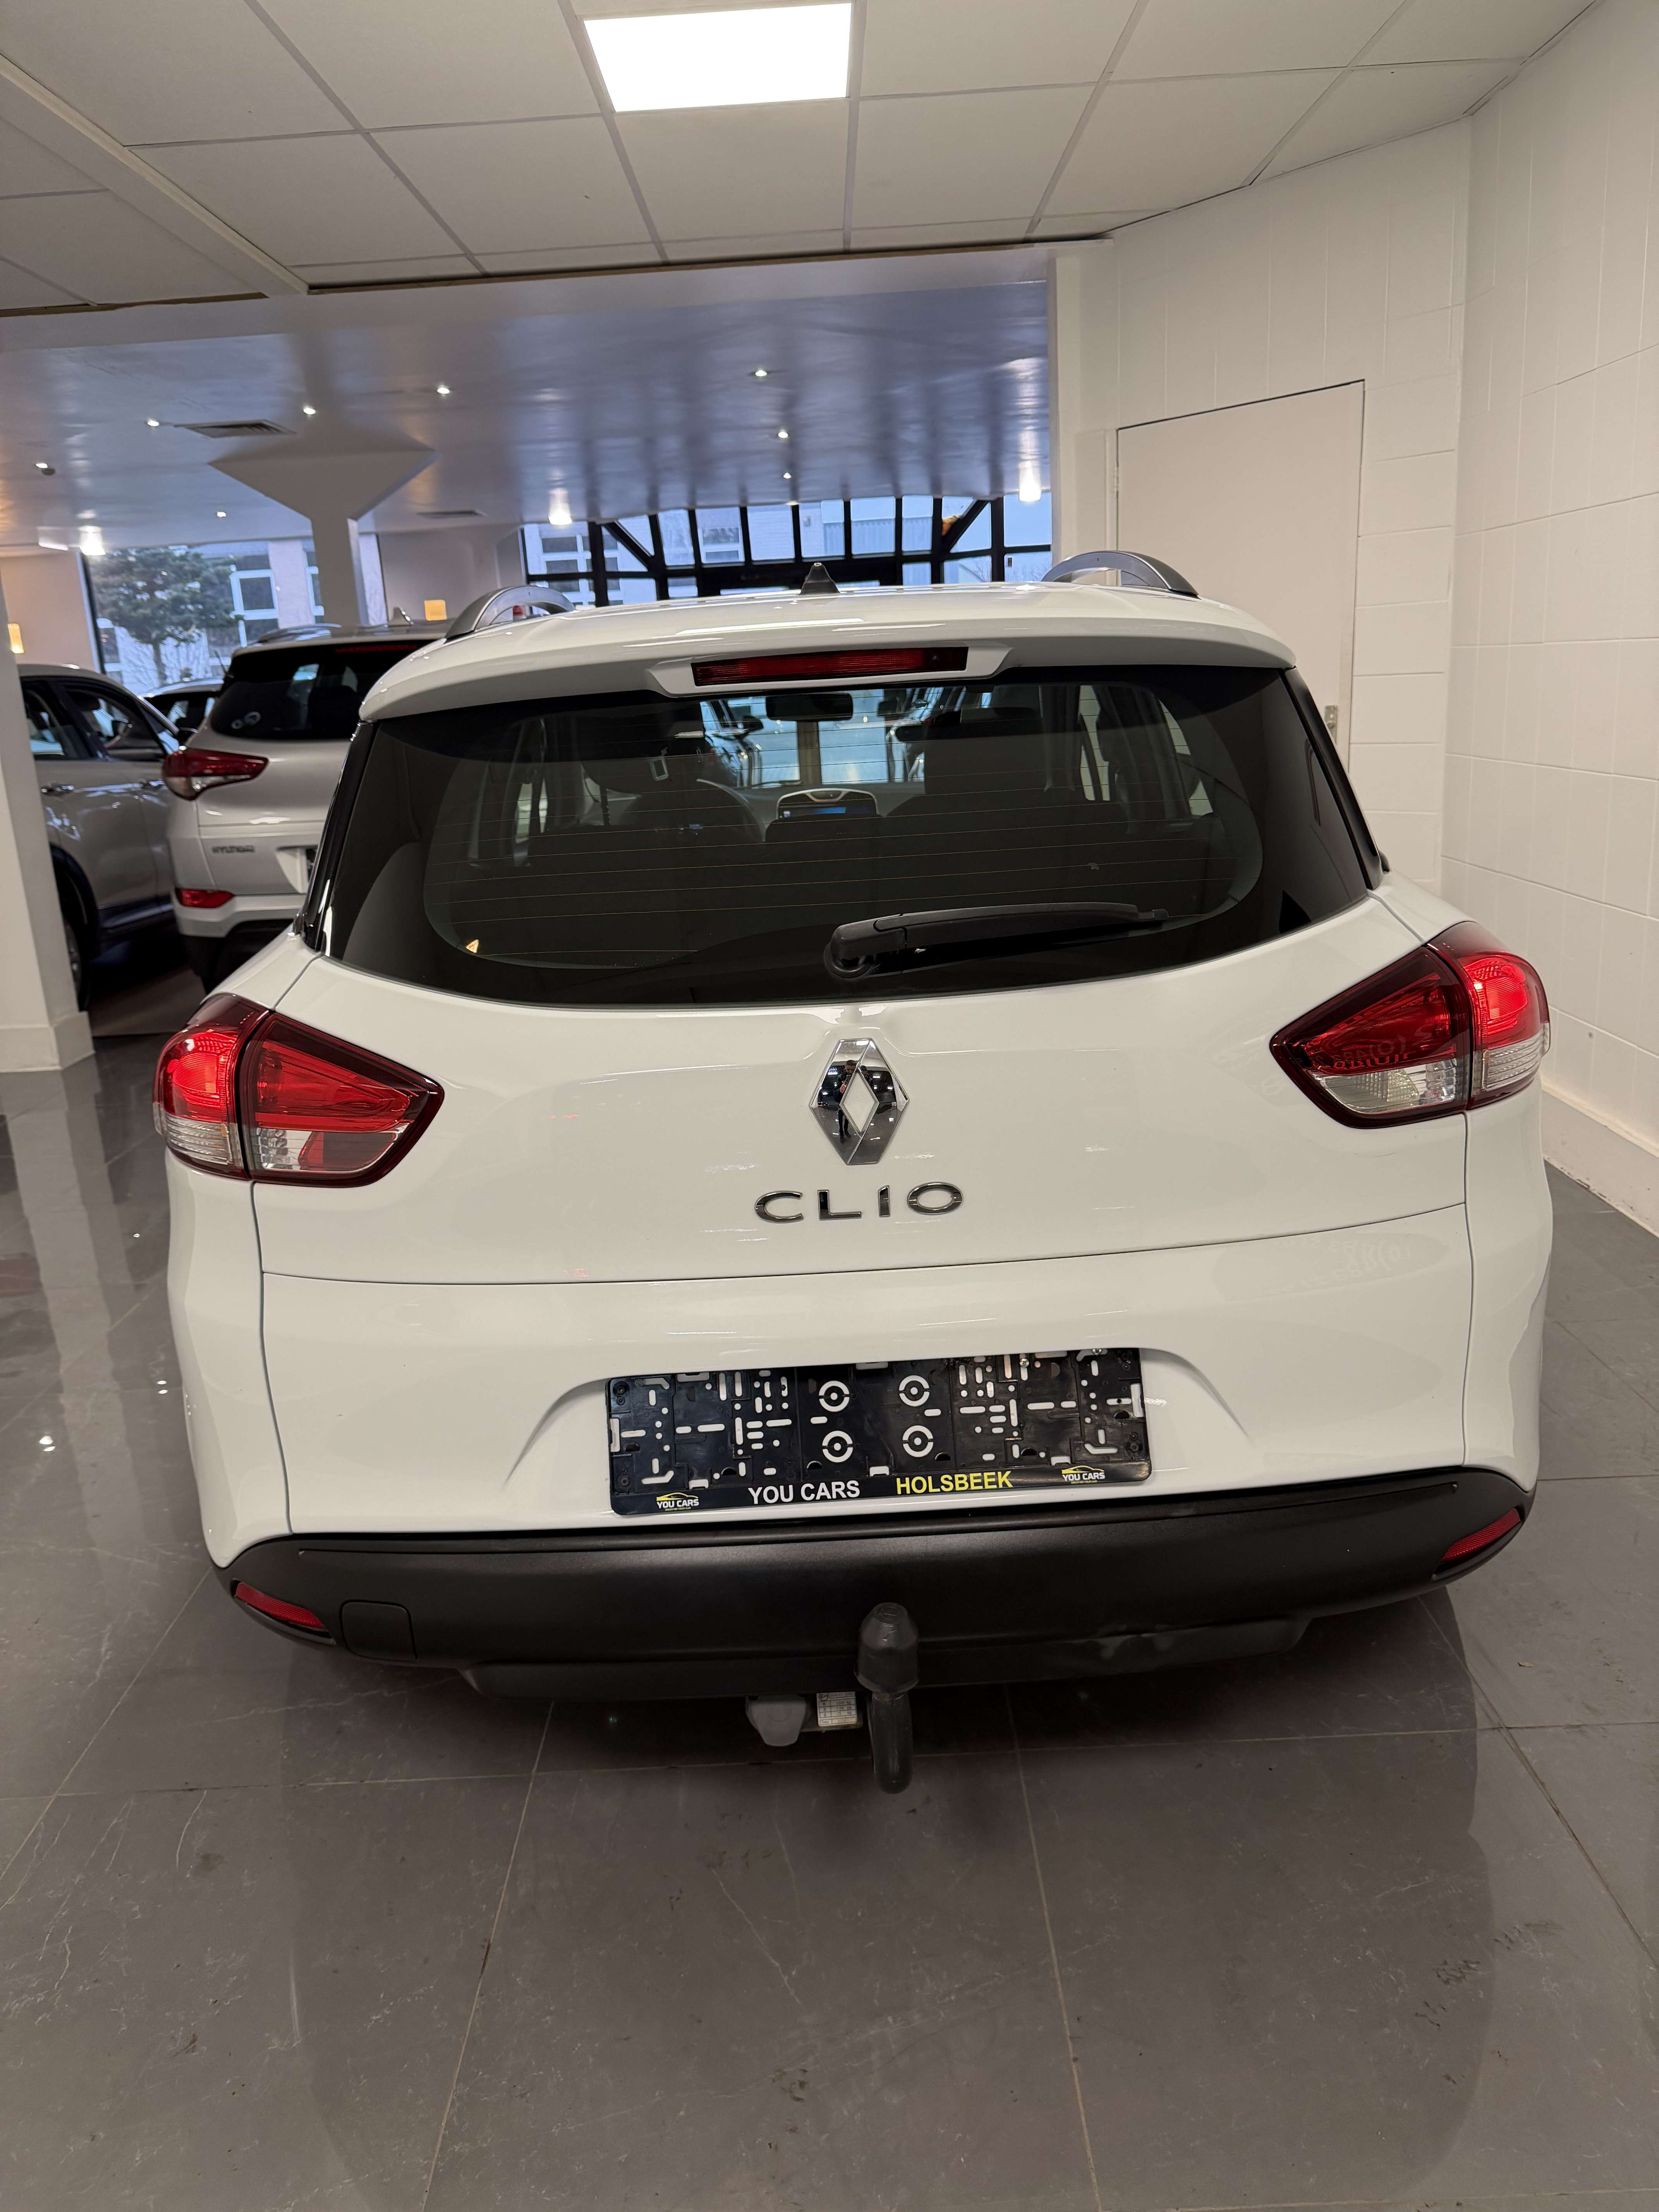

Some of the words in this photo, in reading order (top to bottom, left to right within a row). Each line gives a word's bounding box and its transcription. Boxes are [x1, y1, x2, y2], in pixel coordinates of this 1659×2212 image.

[754, 1182, 963, 1224] CLIO
[748, 1484, 793, 1504] YOU
[800, 1480, 860, 1501] CARS
[896, 1471, 1013, 1495] HOLSBEEK
[1062, 1473, 1080, 1482] YOU
[1082, 1472, 1105, 1480] CARS
[656, 1500, 674, 1509] YOU
[677, 1499, 699, 1507] CARS
